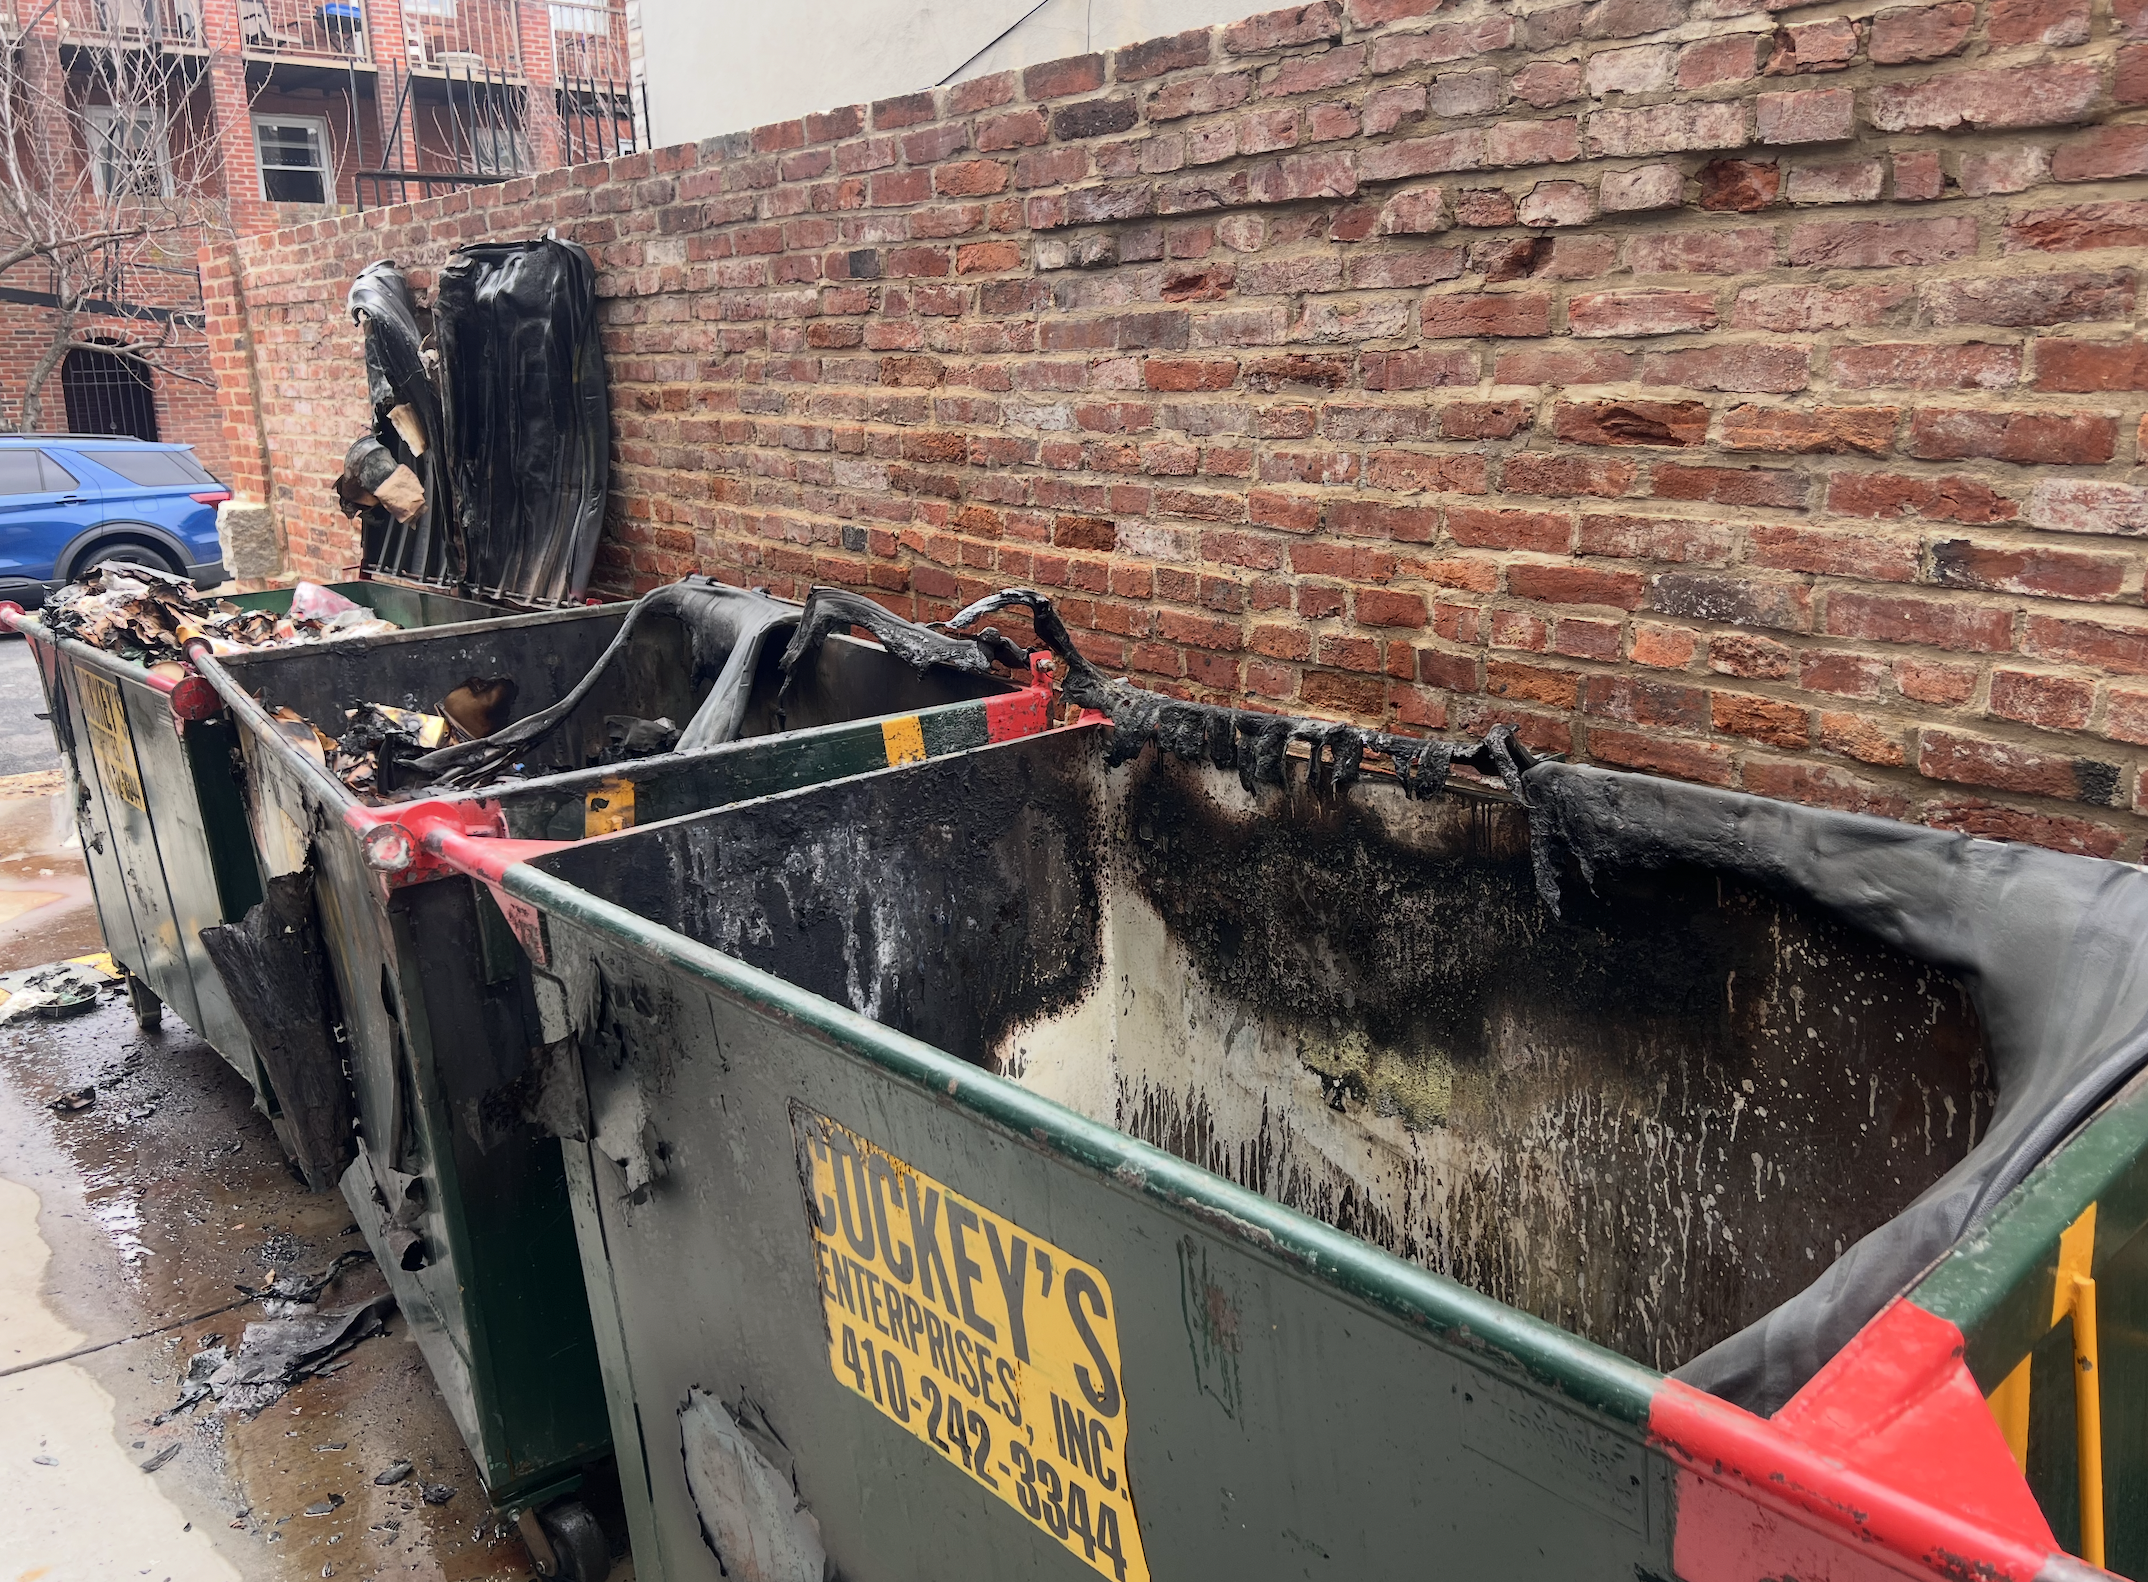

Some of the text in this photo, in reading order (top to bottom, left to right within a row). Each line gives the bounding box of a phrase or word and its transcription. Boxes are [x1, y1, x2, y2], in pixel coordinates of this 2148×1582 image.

[799, 1112, 1121, 1418] COCKEY'S
[819, 1240, 1128, 1502] ENTERPRISES, INC.
[842, 1322, 1128, 1582] 410-242-3344
